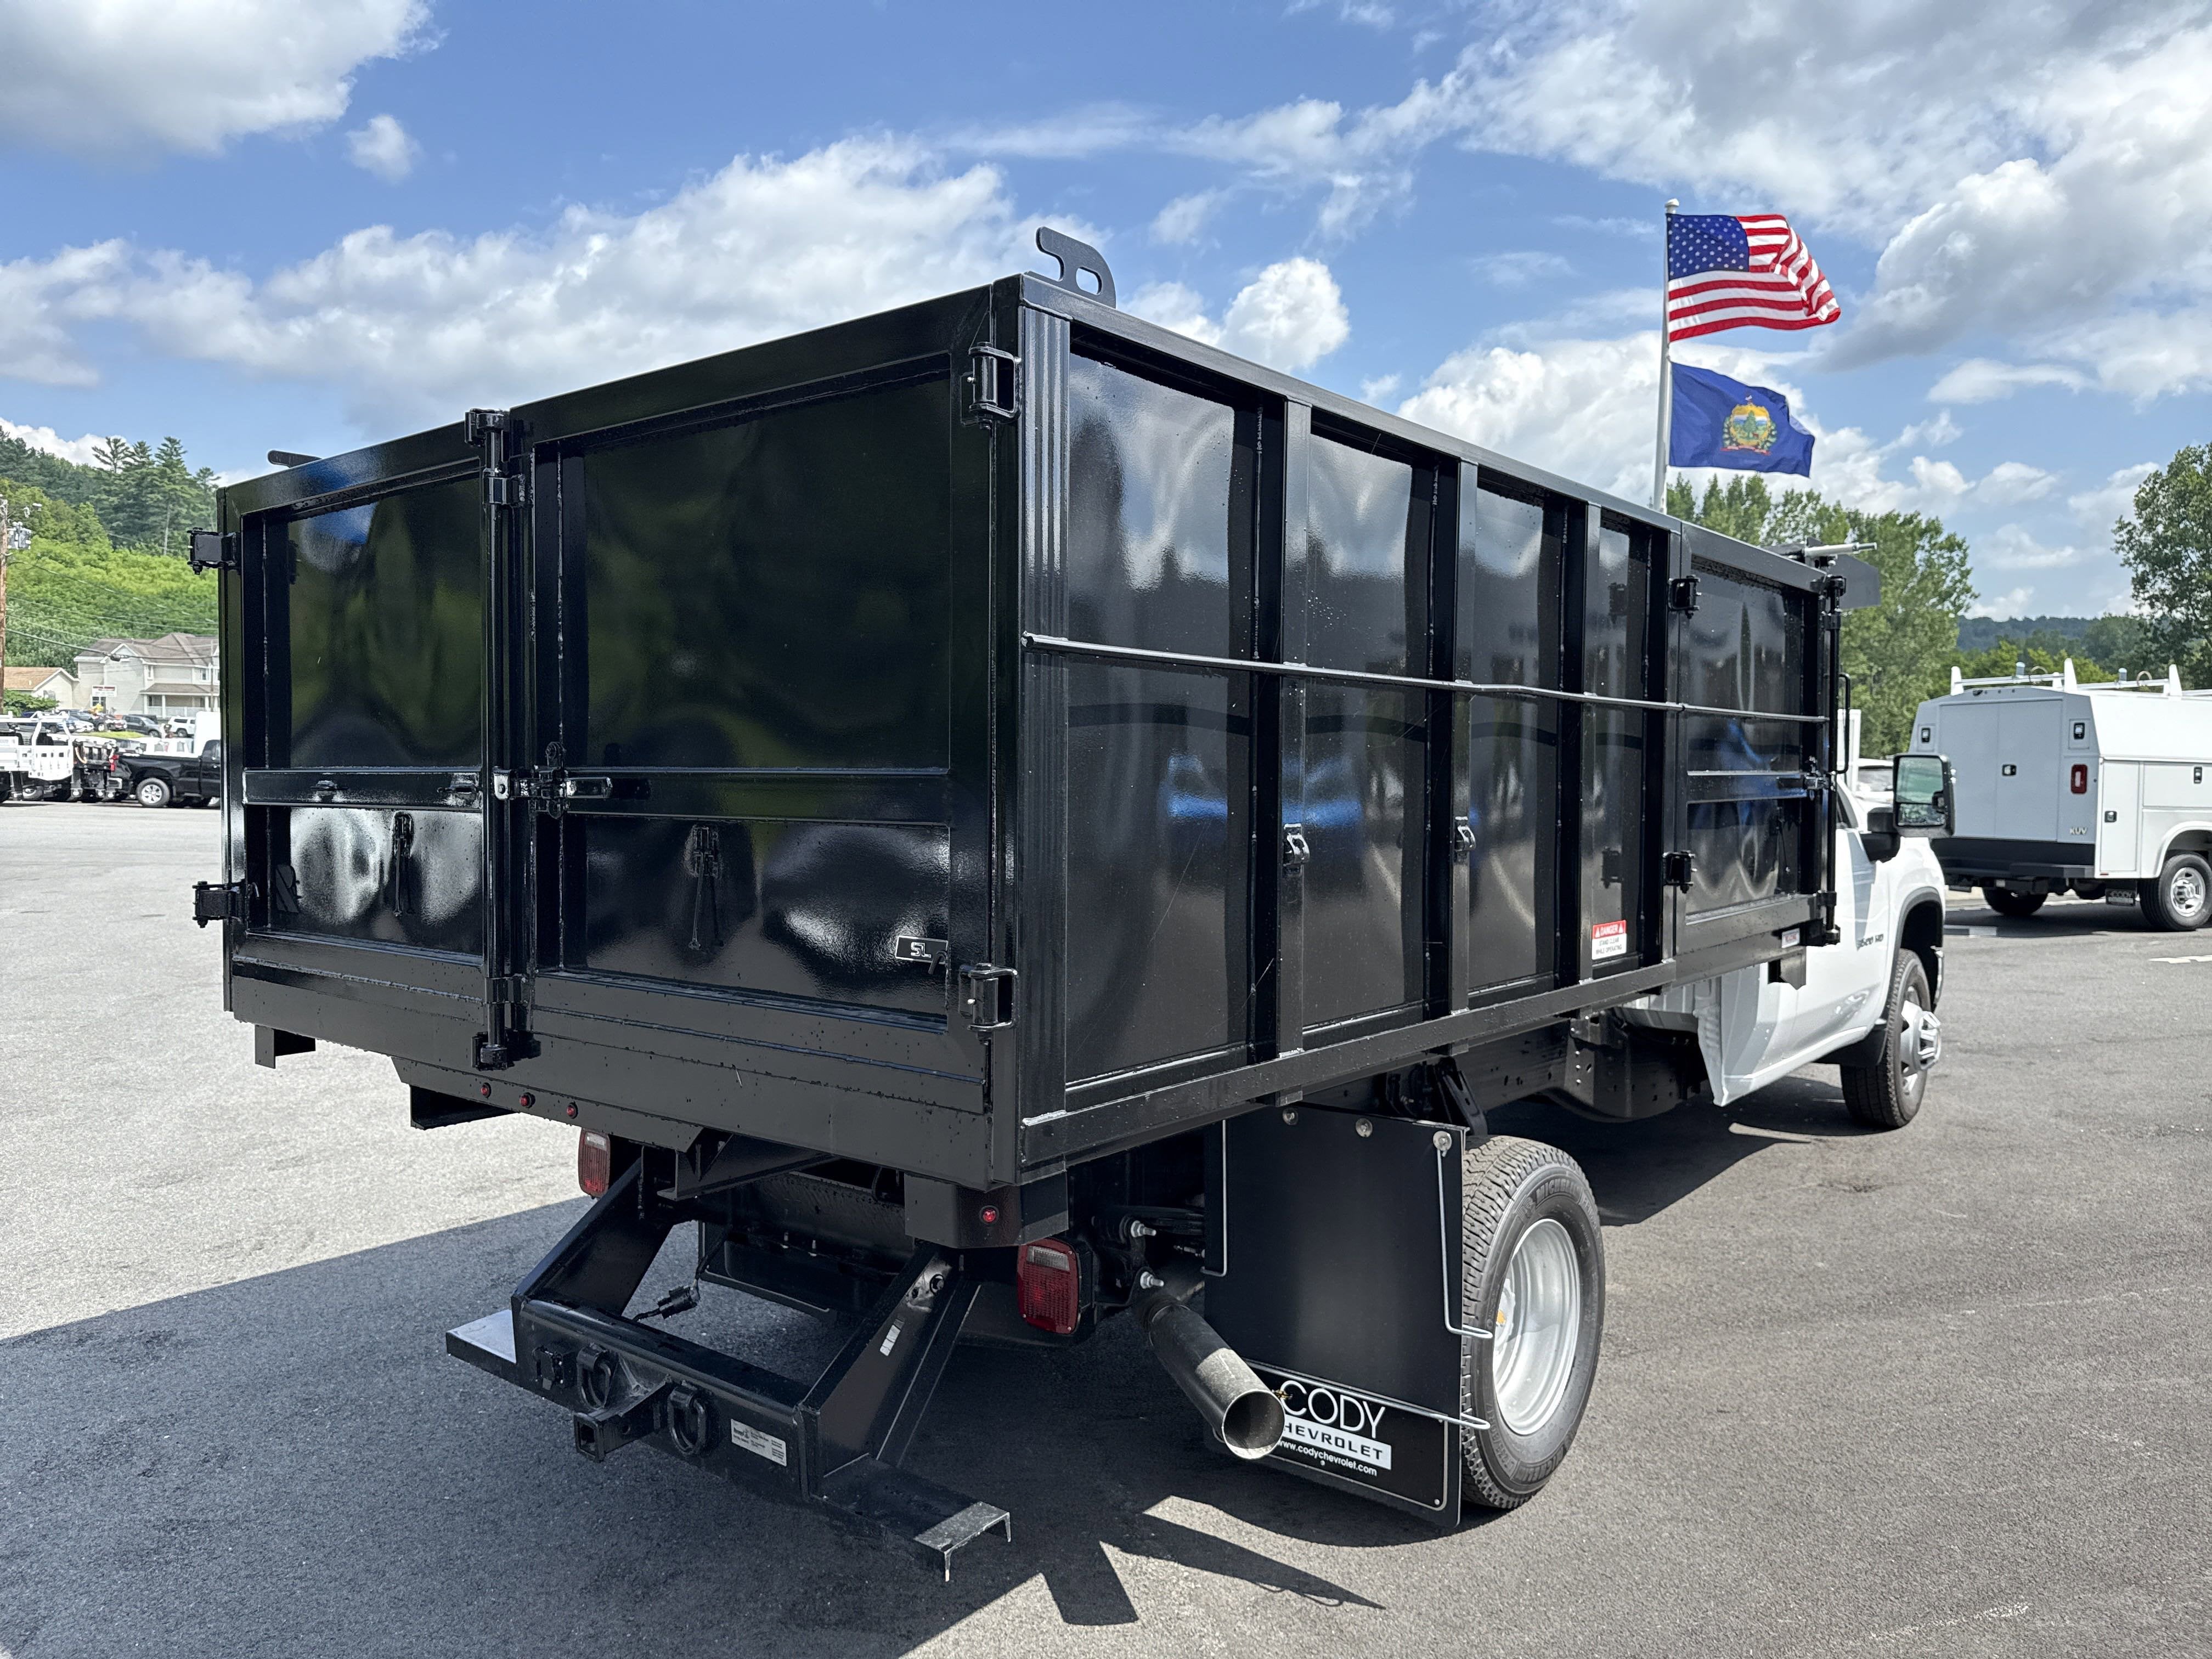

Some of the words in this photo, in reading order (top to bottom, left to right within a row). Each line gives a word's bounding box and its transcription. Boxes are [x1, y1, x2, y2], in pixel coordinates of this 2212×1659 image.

[1600, 924, 1618, 935] DANGER
[911, 941, 932, 958] SL
[1279, 1380, 1386, 1438] CODY
[1284, 1423, 1383, 1460] HEVROLET
